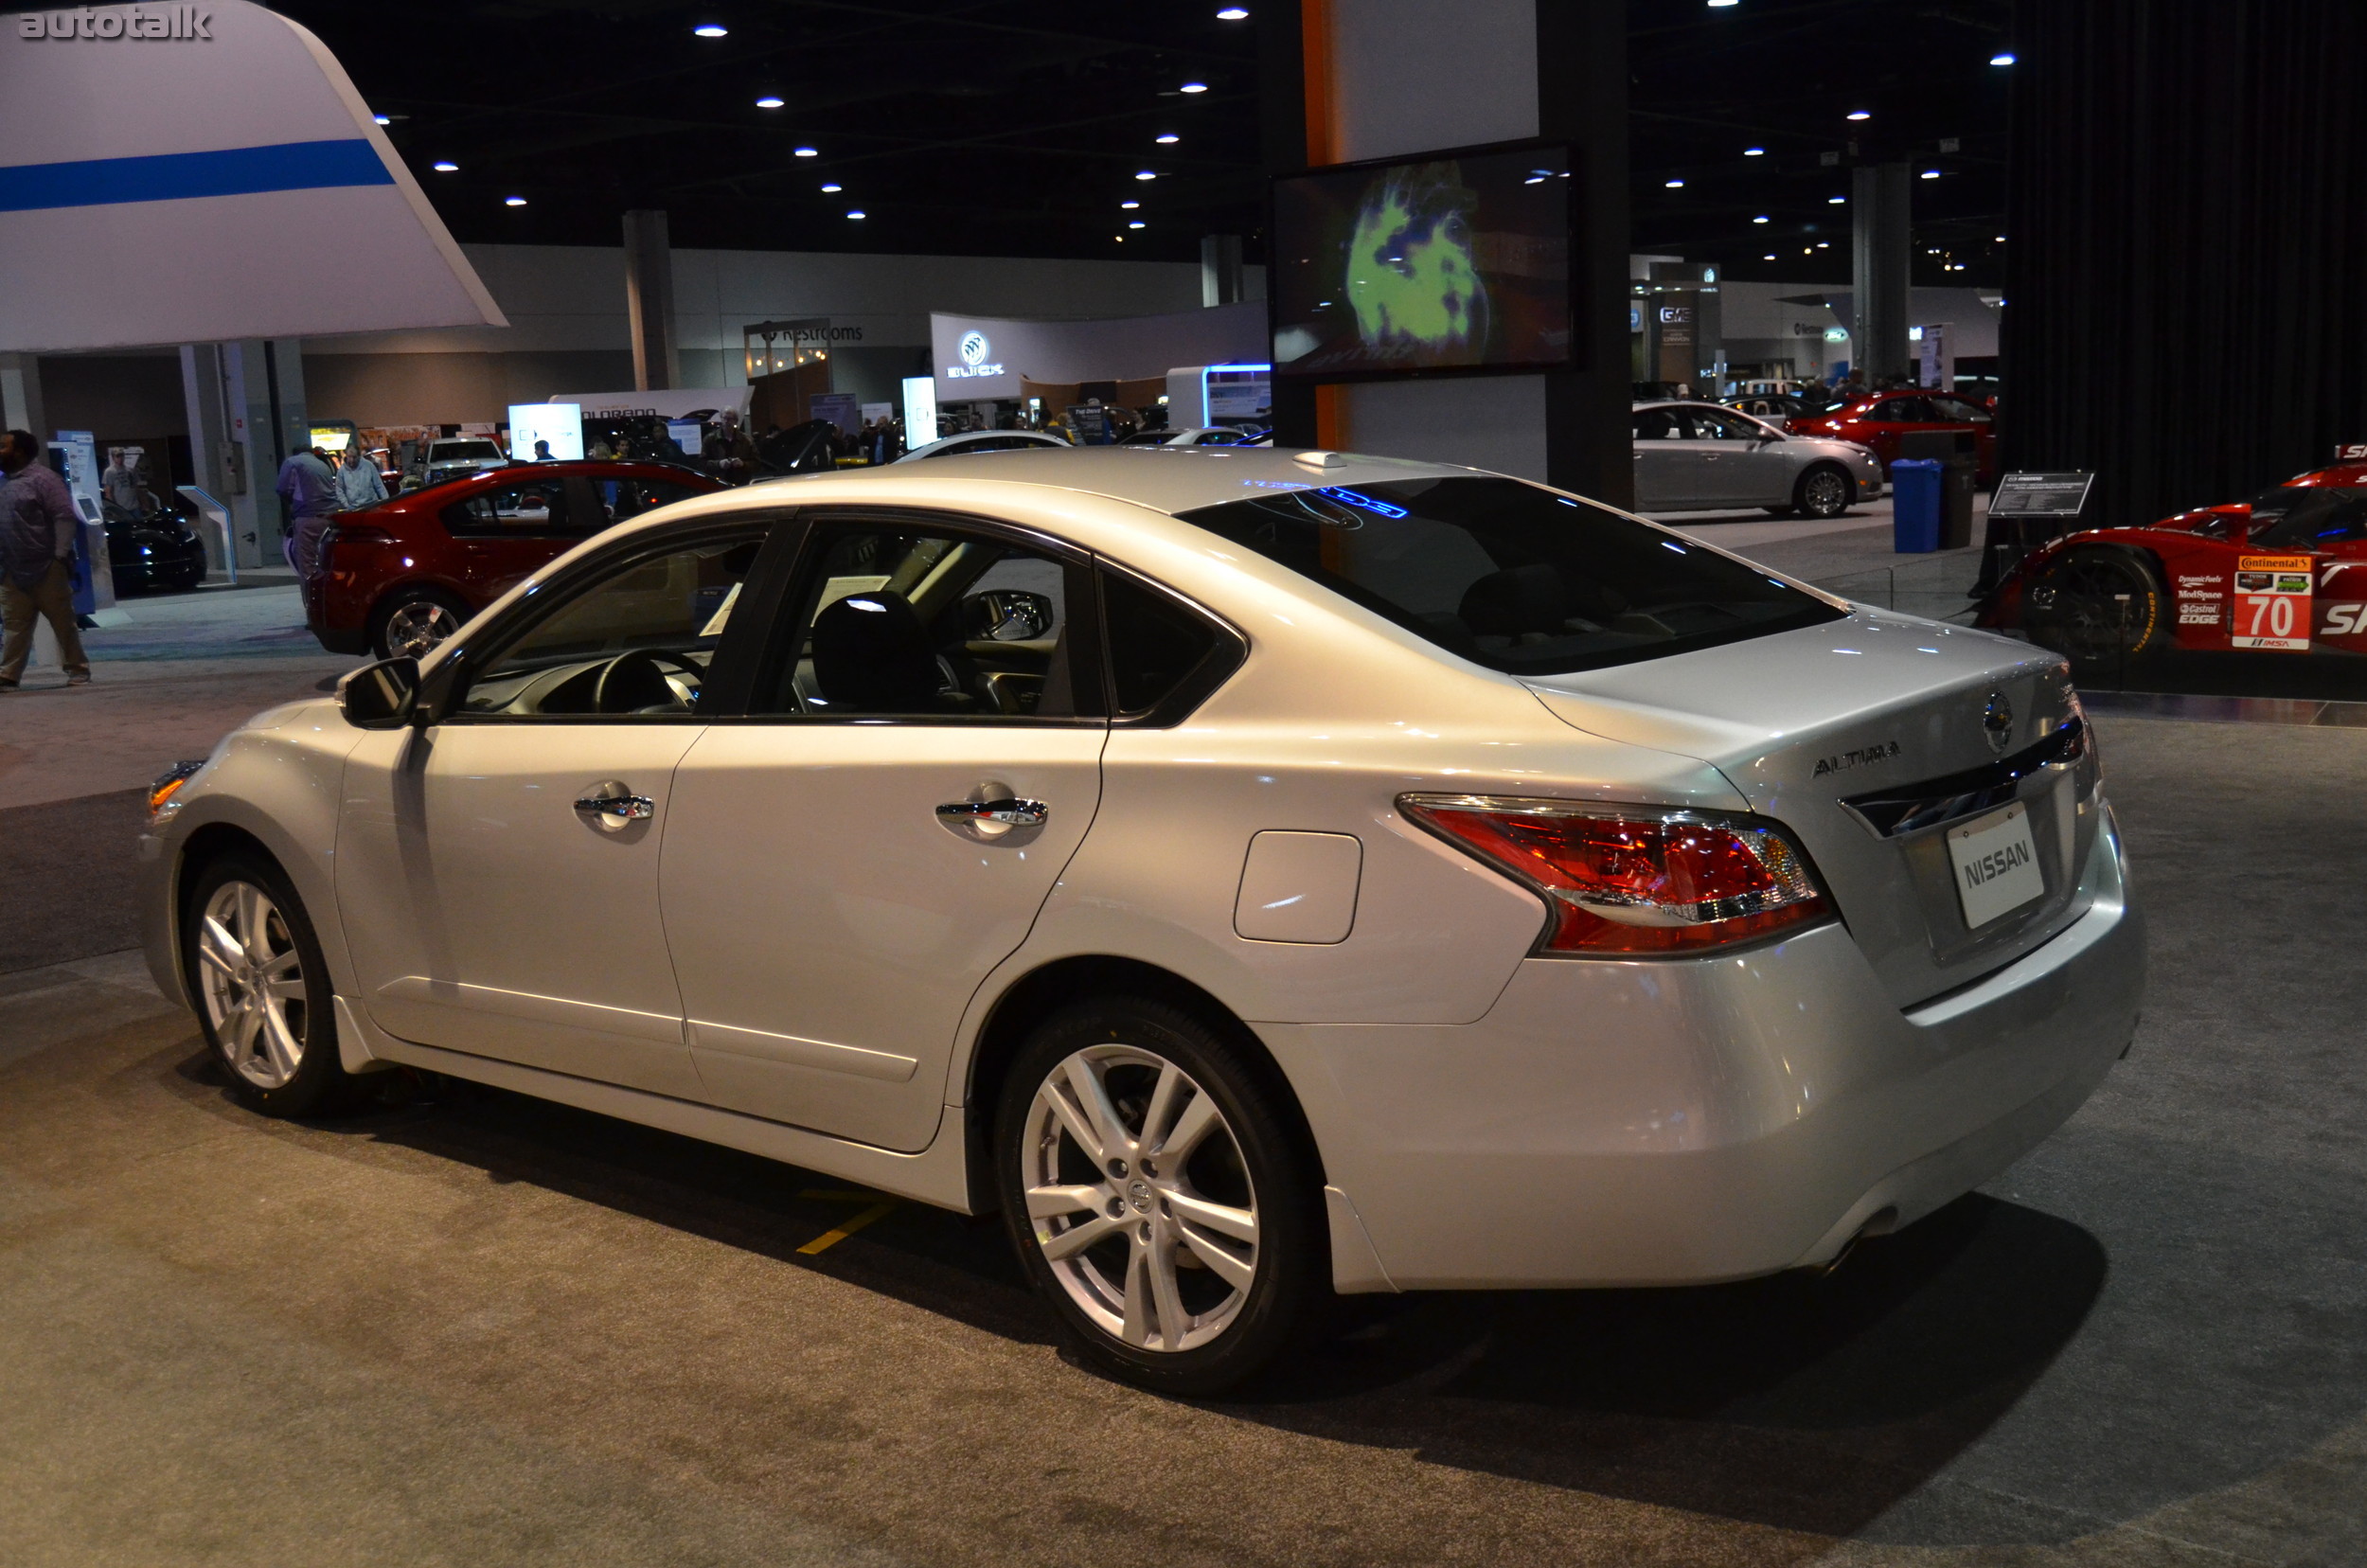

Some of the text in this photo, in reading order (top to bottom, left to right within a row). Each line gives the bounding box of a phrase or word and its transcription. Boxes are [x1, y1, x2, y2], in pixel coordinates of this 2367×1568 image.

[947, 365, 1005, 378] BUICK
[2241, 557, 2298, 569] Continental
[2178, 590, 2223, 601] ModSpace
[2189, 604, 2216, 614] Castrol
[2179, 615, 2221, 624] EDGE
[2248, 596, 2294, 637] 70
[1810, 740, 1902, 779] ALTIMA
[1964, 839, 2030, 889] NISSAN
